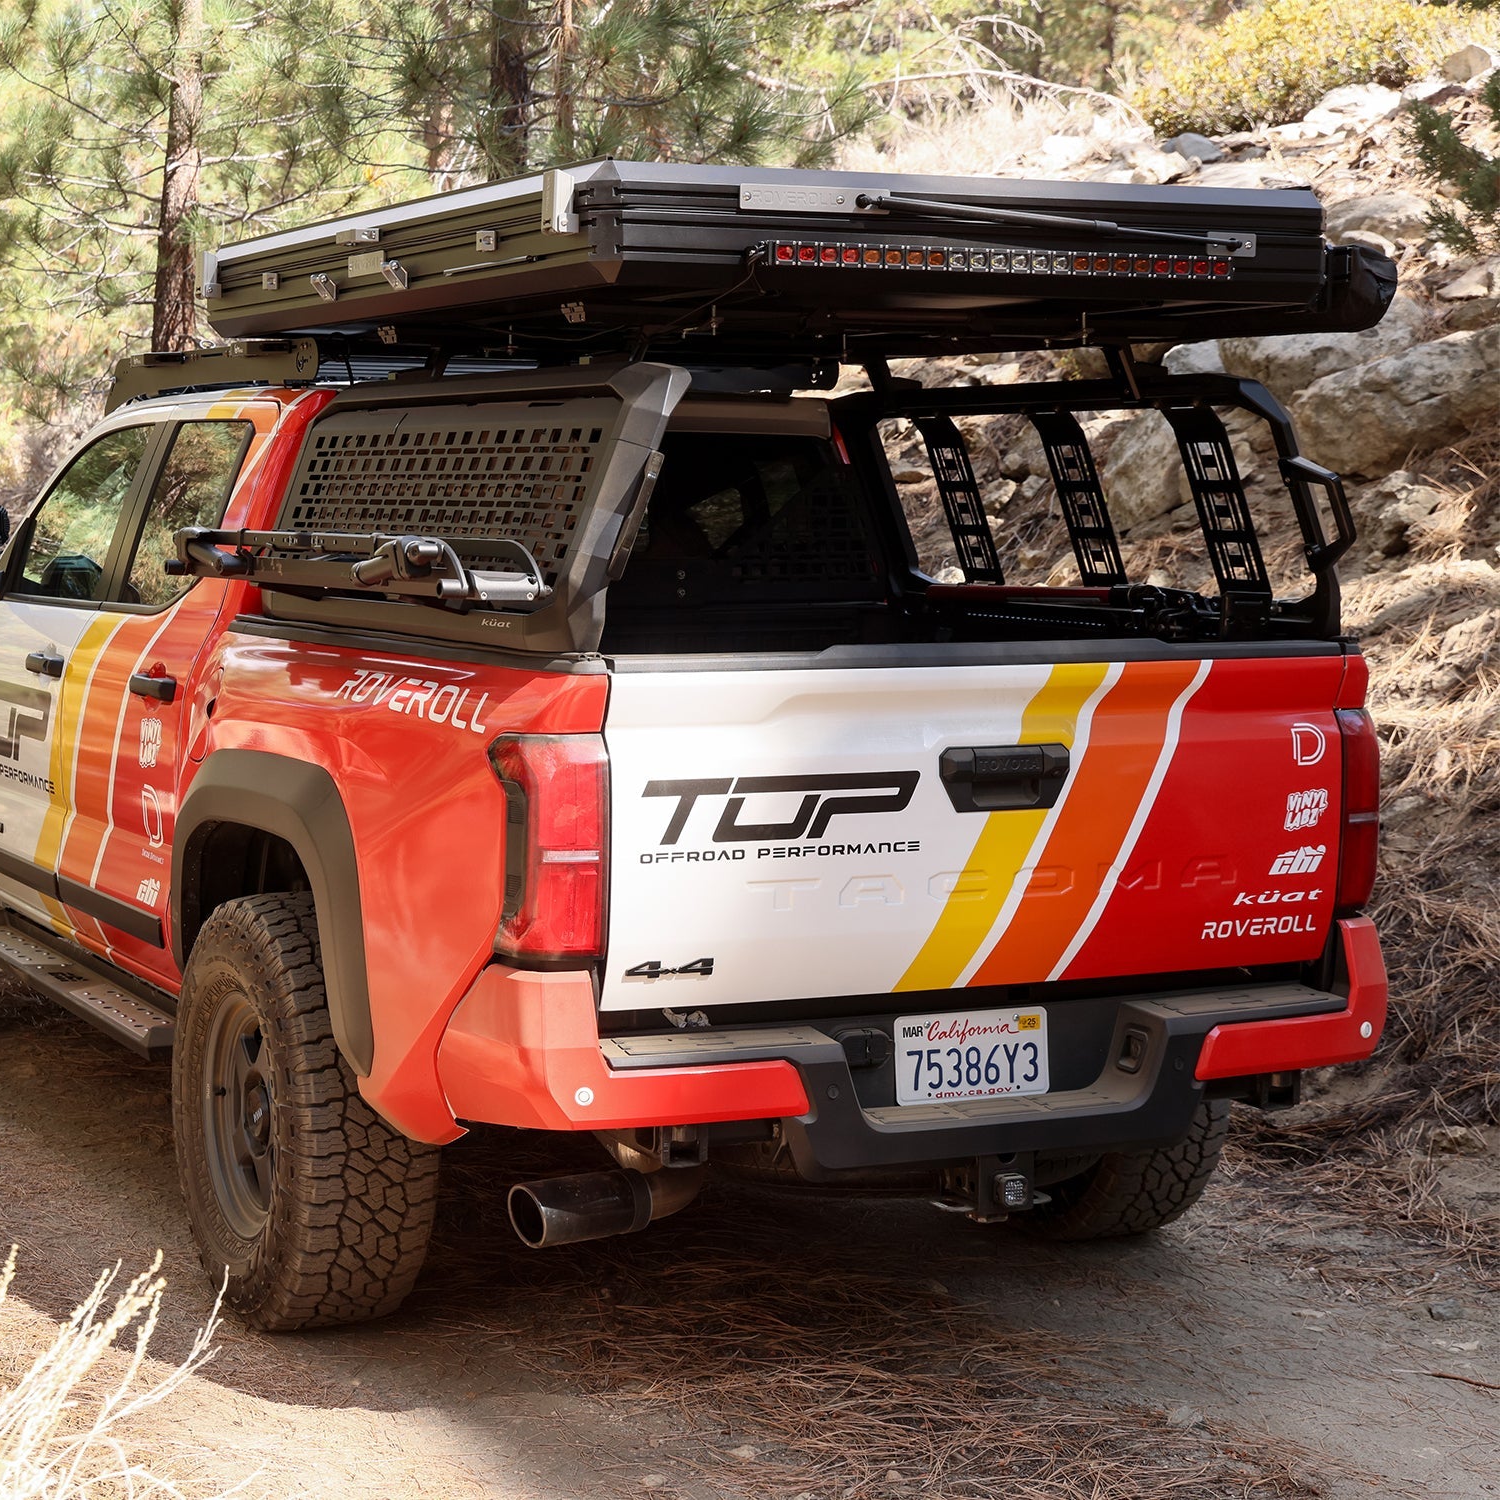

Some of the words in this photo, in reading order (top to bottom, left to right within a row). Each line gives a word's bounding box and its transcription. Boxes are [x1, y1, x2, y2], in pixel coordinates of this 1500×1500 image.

[751, 188, 838, 208] ROVEROLL
[481, 618, 511, 628] küat
[334, 669, 490, 734] ROVEROLL
[979, 758, 1041, 772] TOYOTA
[0, 763, 56, 795] PERFORMANCE
[641, 770, 921, 846] TOP
[1284, 808, 1321, 831] LABZ
[640, 848, 745, 865] OFFROAD
[757, 840, 921, 859] PERFORMANCE
[746, 854, 1238, 912] TACOMA
[1233, 888, 1324, 906] küat
[1201, 914, 1317, 940] ROVEROLL
[902, 1025, 924, 1039] MAR
[927, 1017, 1020, 1046] California
[1027, 1017, 1037, 1026] 25
[906, 1041, 1039, 1092] 75386Y3
[935, 1085, 1013, 1099] dmv.ca.gov
